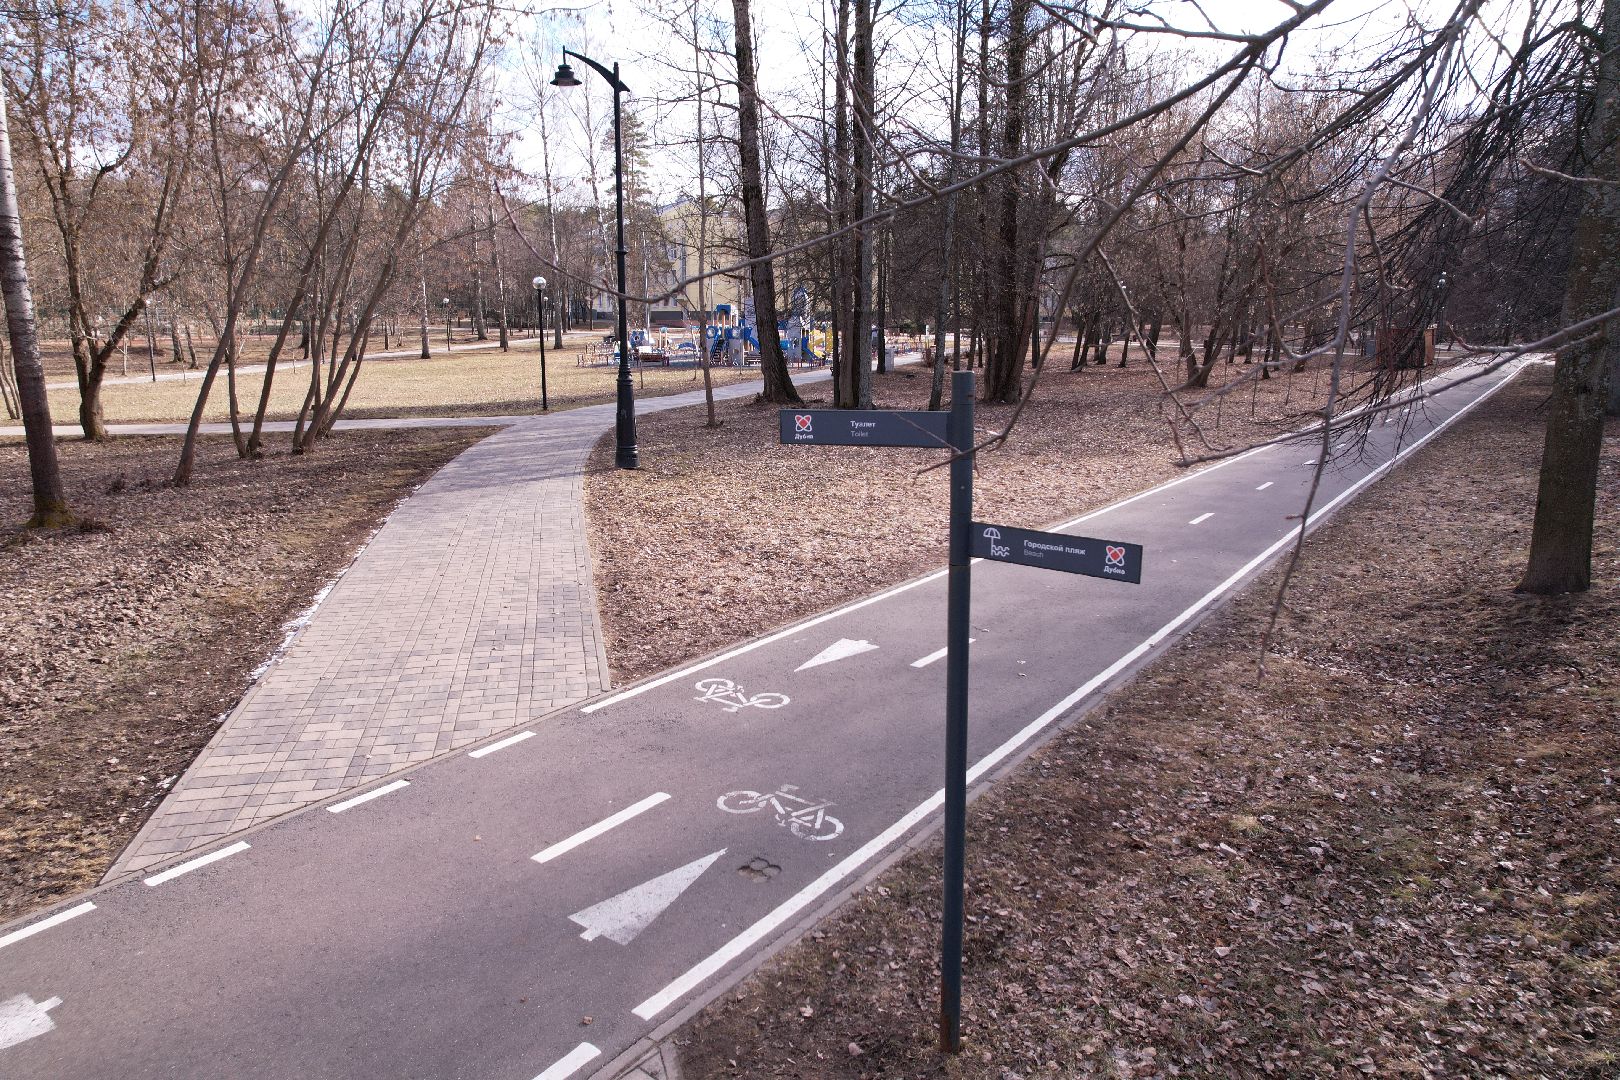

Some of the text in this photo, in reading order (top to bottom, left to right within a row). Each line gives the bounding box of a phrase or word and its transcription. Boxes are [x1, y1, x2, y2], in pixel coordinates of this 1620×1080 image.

[850, 420, 876, 428] Туалет
[1023, 539, 1086, 555] Городской пляж
[1023, 549, 1044, 558] Beach
